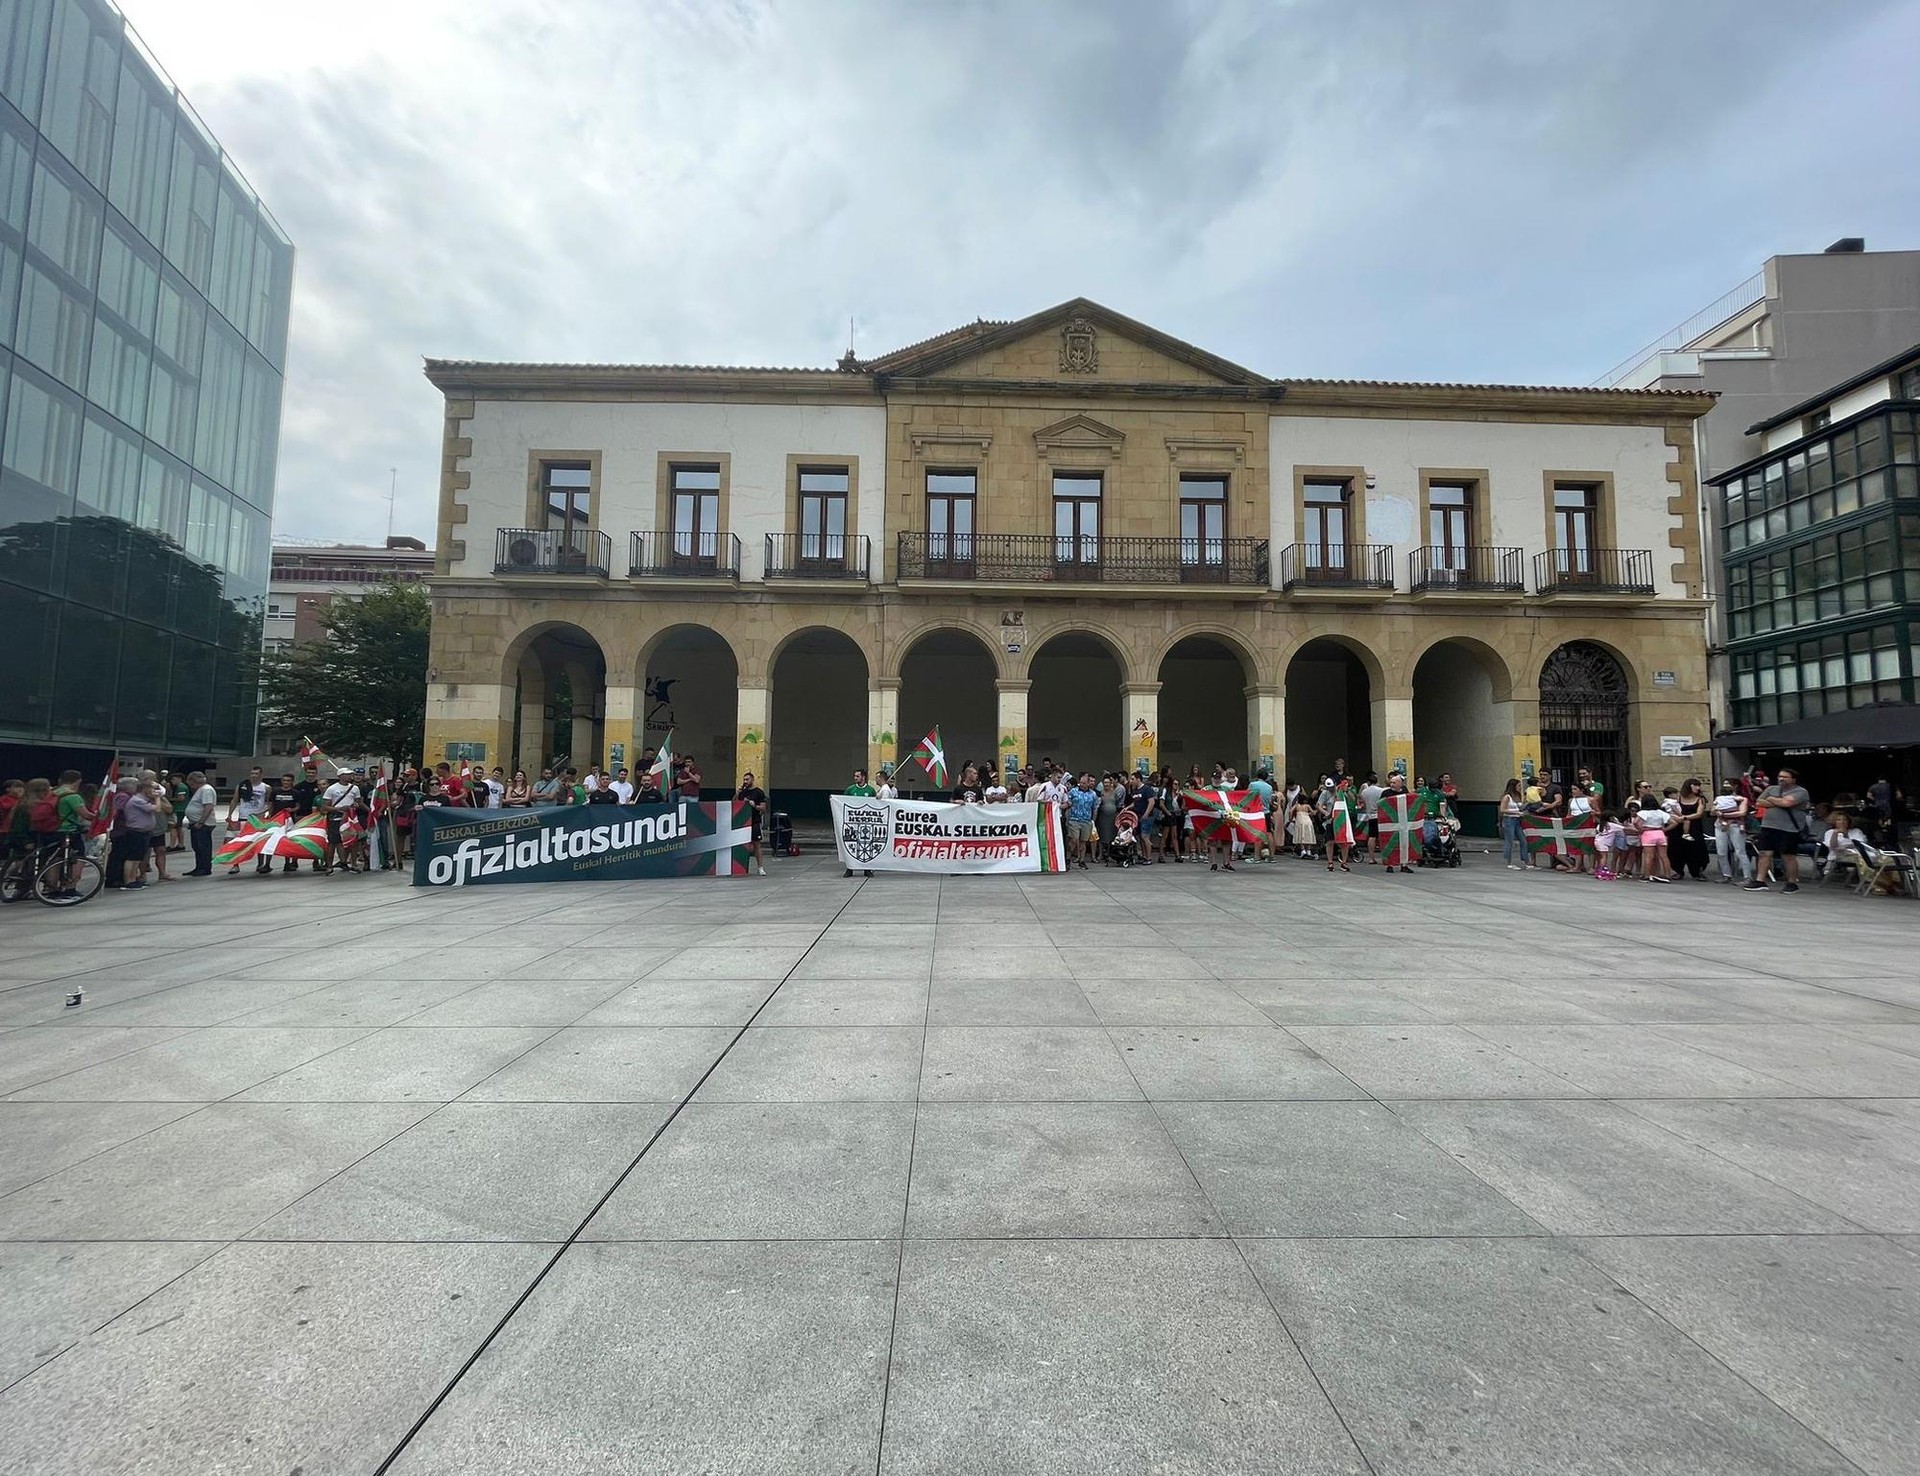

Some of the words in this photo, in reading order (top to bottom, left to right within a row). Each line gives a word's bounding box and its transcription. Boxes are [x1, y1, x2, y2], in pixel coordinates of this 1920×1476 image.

[896, 809, 938, 823] Gurea
[434, 826, 479, 842] EUSKAL
[480, 815, 540, 834] SELEKZIOA
[895, 823, 951, 837] EUSKAL
[954, 824, 1028, 837] SELEKZIOA
[428, 803, 688, 886] ofizialtasuna!
[894, 840, 1029, 860] ofizialtasuna!
[573, 857, 604, 871] Euskal
